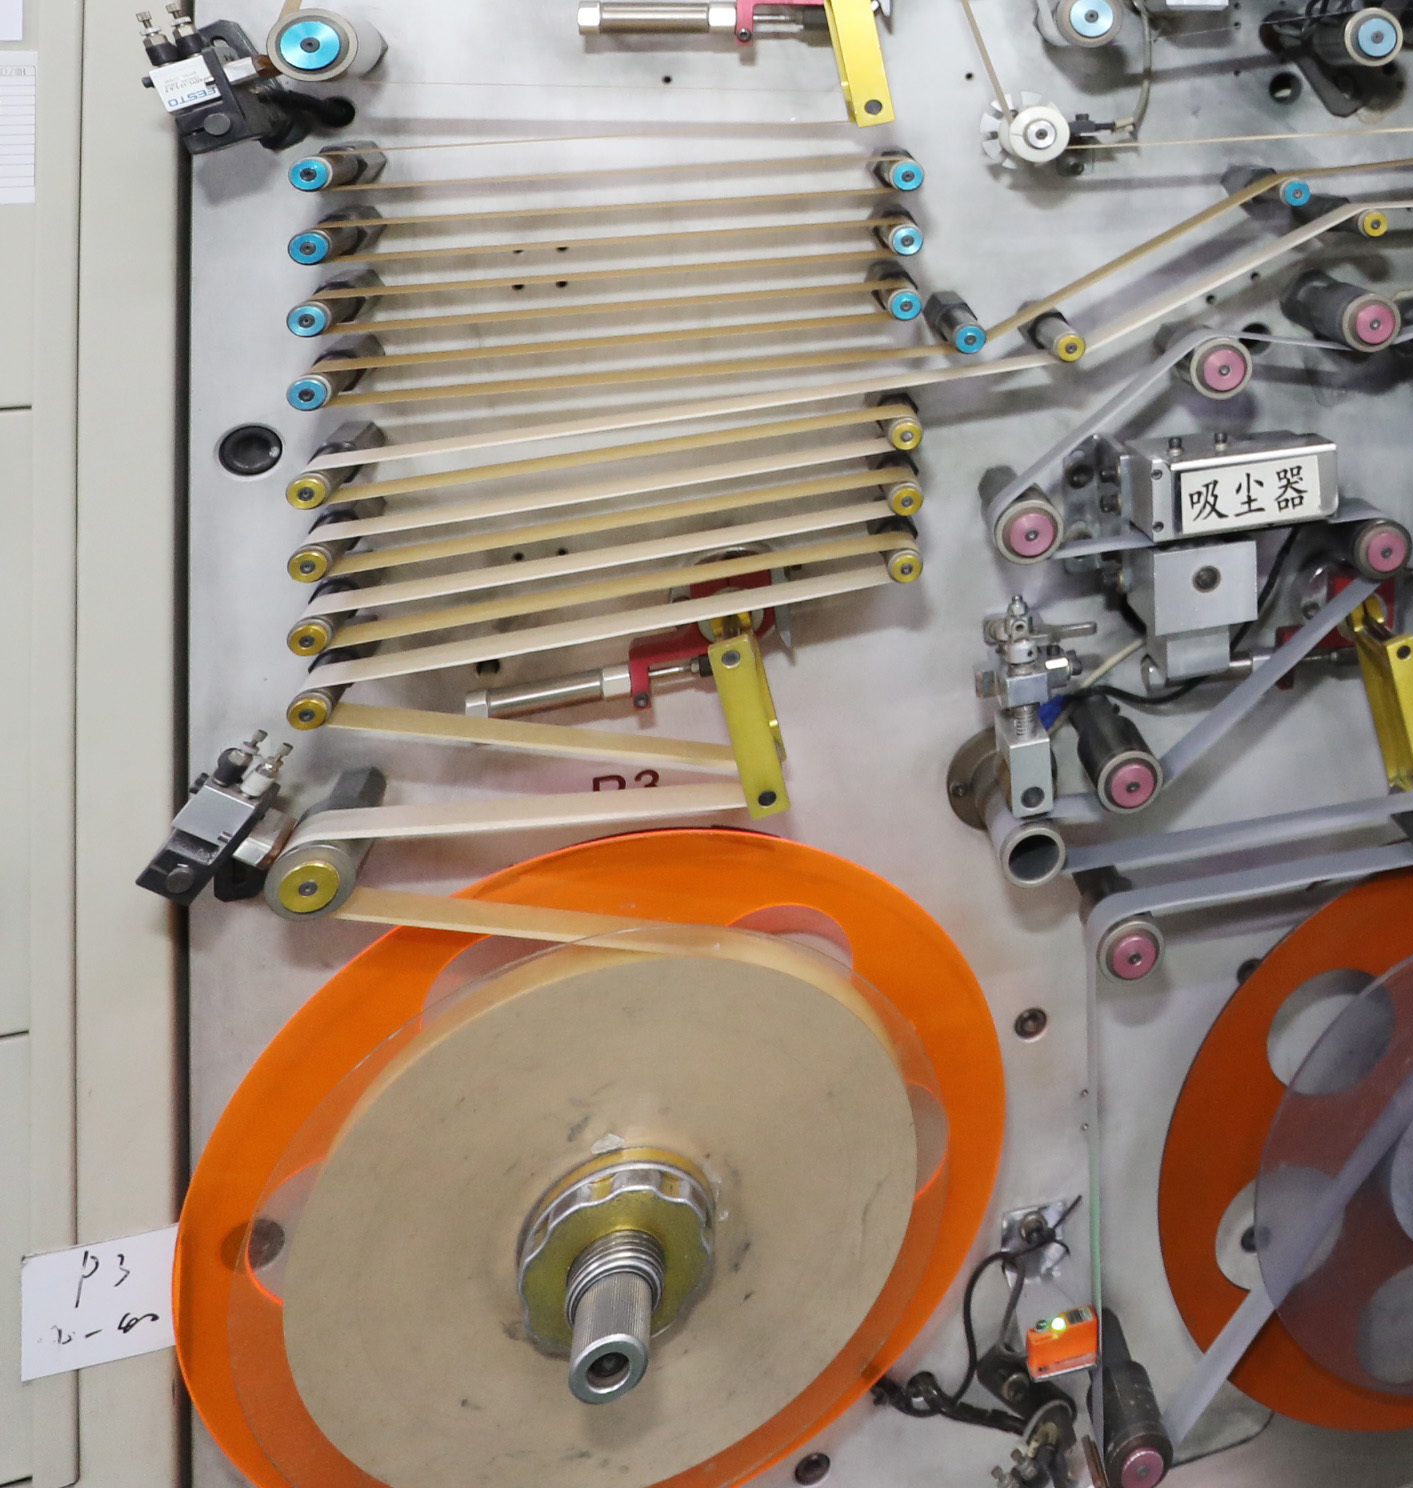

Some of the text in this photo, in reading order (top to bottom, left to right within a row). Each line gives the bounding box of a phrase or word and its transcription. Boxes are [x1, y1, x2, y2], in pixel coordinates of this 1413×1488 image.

[168, 87, 217, 107] FESTO
[1189, 465, 1308, 522] 吸尘器
